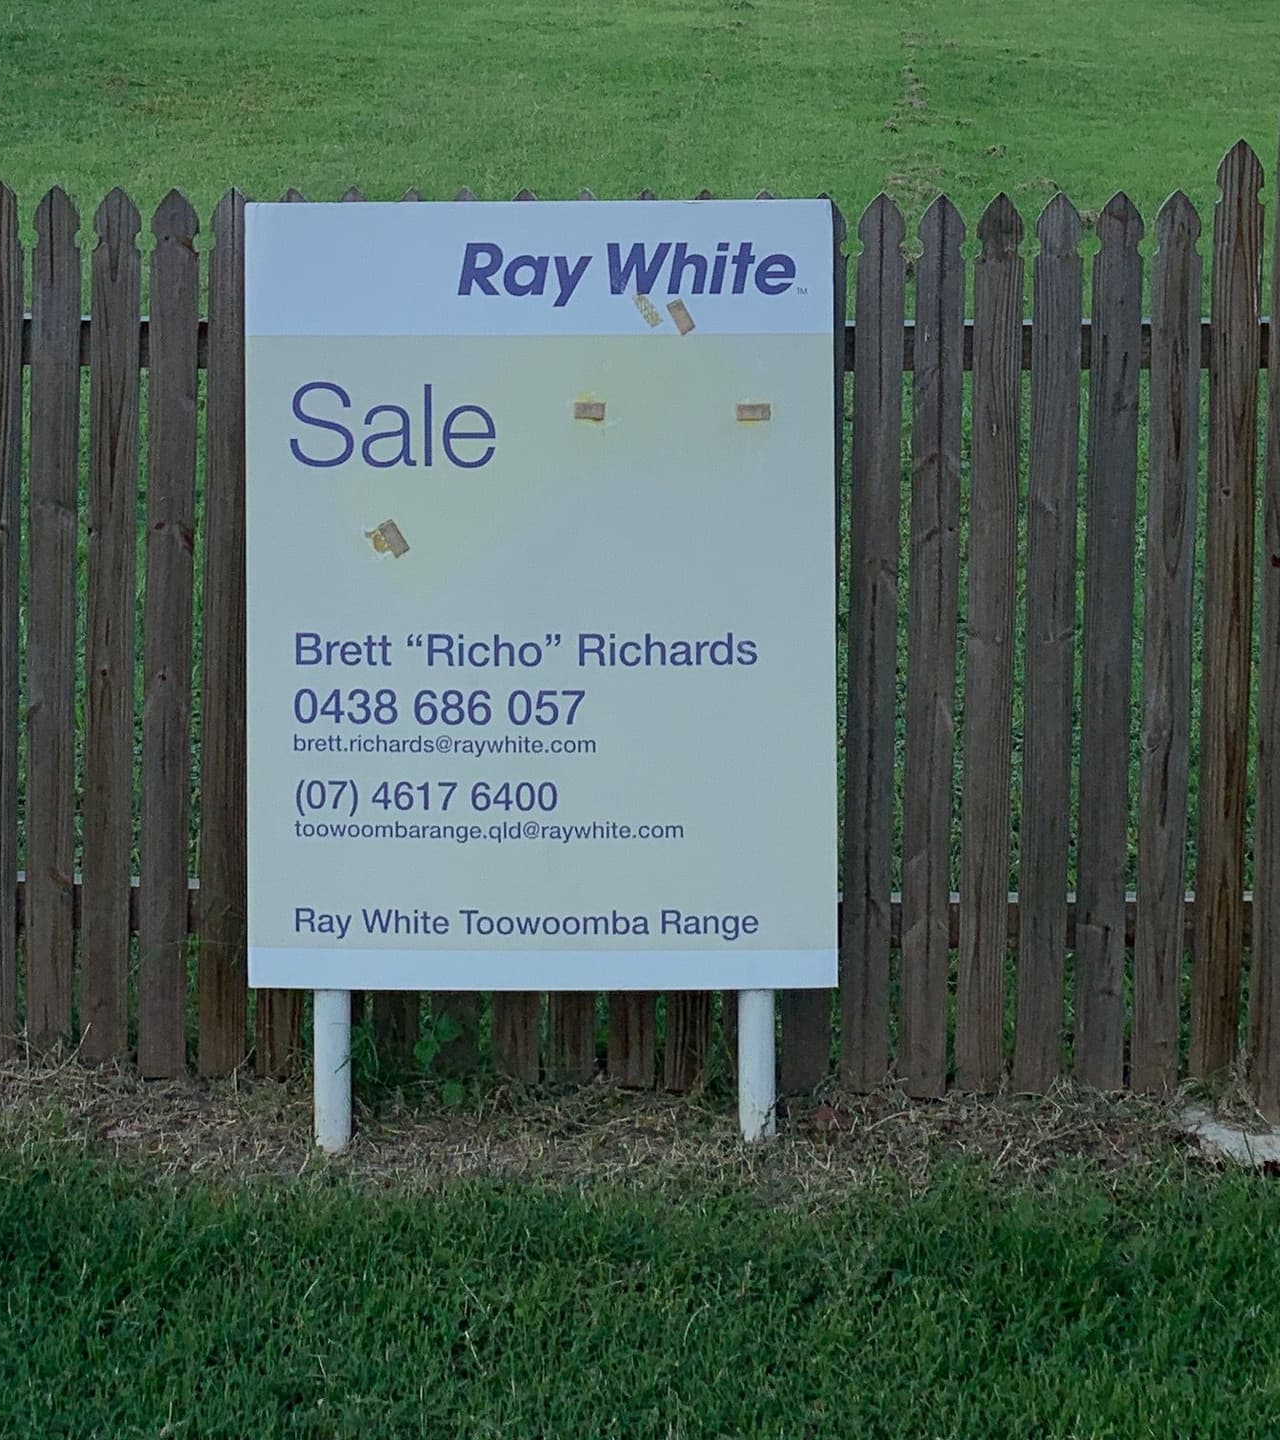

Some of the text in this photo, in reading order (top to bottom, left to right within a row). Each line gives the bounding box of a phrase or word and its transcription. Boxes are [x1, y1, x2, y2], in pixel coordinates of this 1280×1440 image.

[457, 242, 593, 308] Ray
[606, 241, 797, 296] White
[289, 381, 497, 469] Sale
[295, 631, 758, 668] Brett “Richo” Richards
[294, 688, 586, 726] 0438 686 057
[293, 733, 597, 758] brett.richards@raywhite.com
[295, 779, 558, 818] (07) 4617 6400
[294, 819, 684, 844] toowoombarange.qld@raywhite.com
[295, 907, 759, 941] Ray White Toowoomba Range
